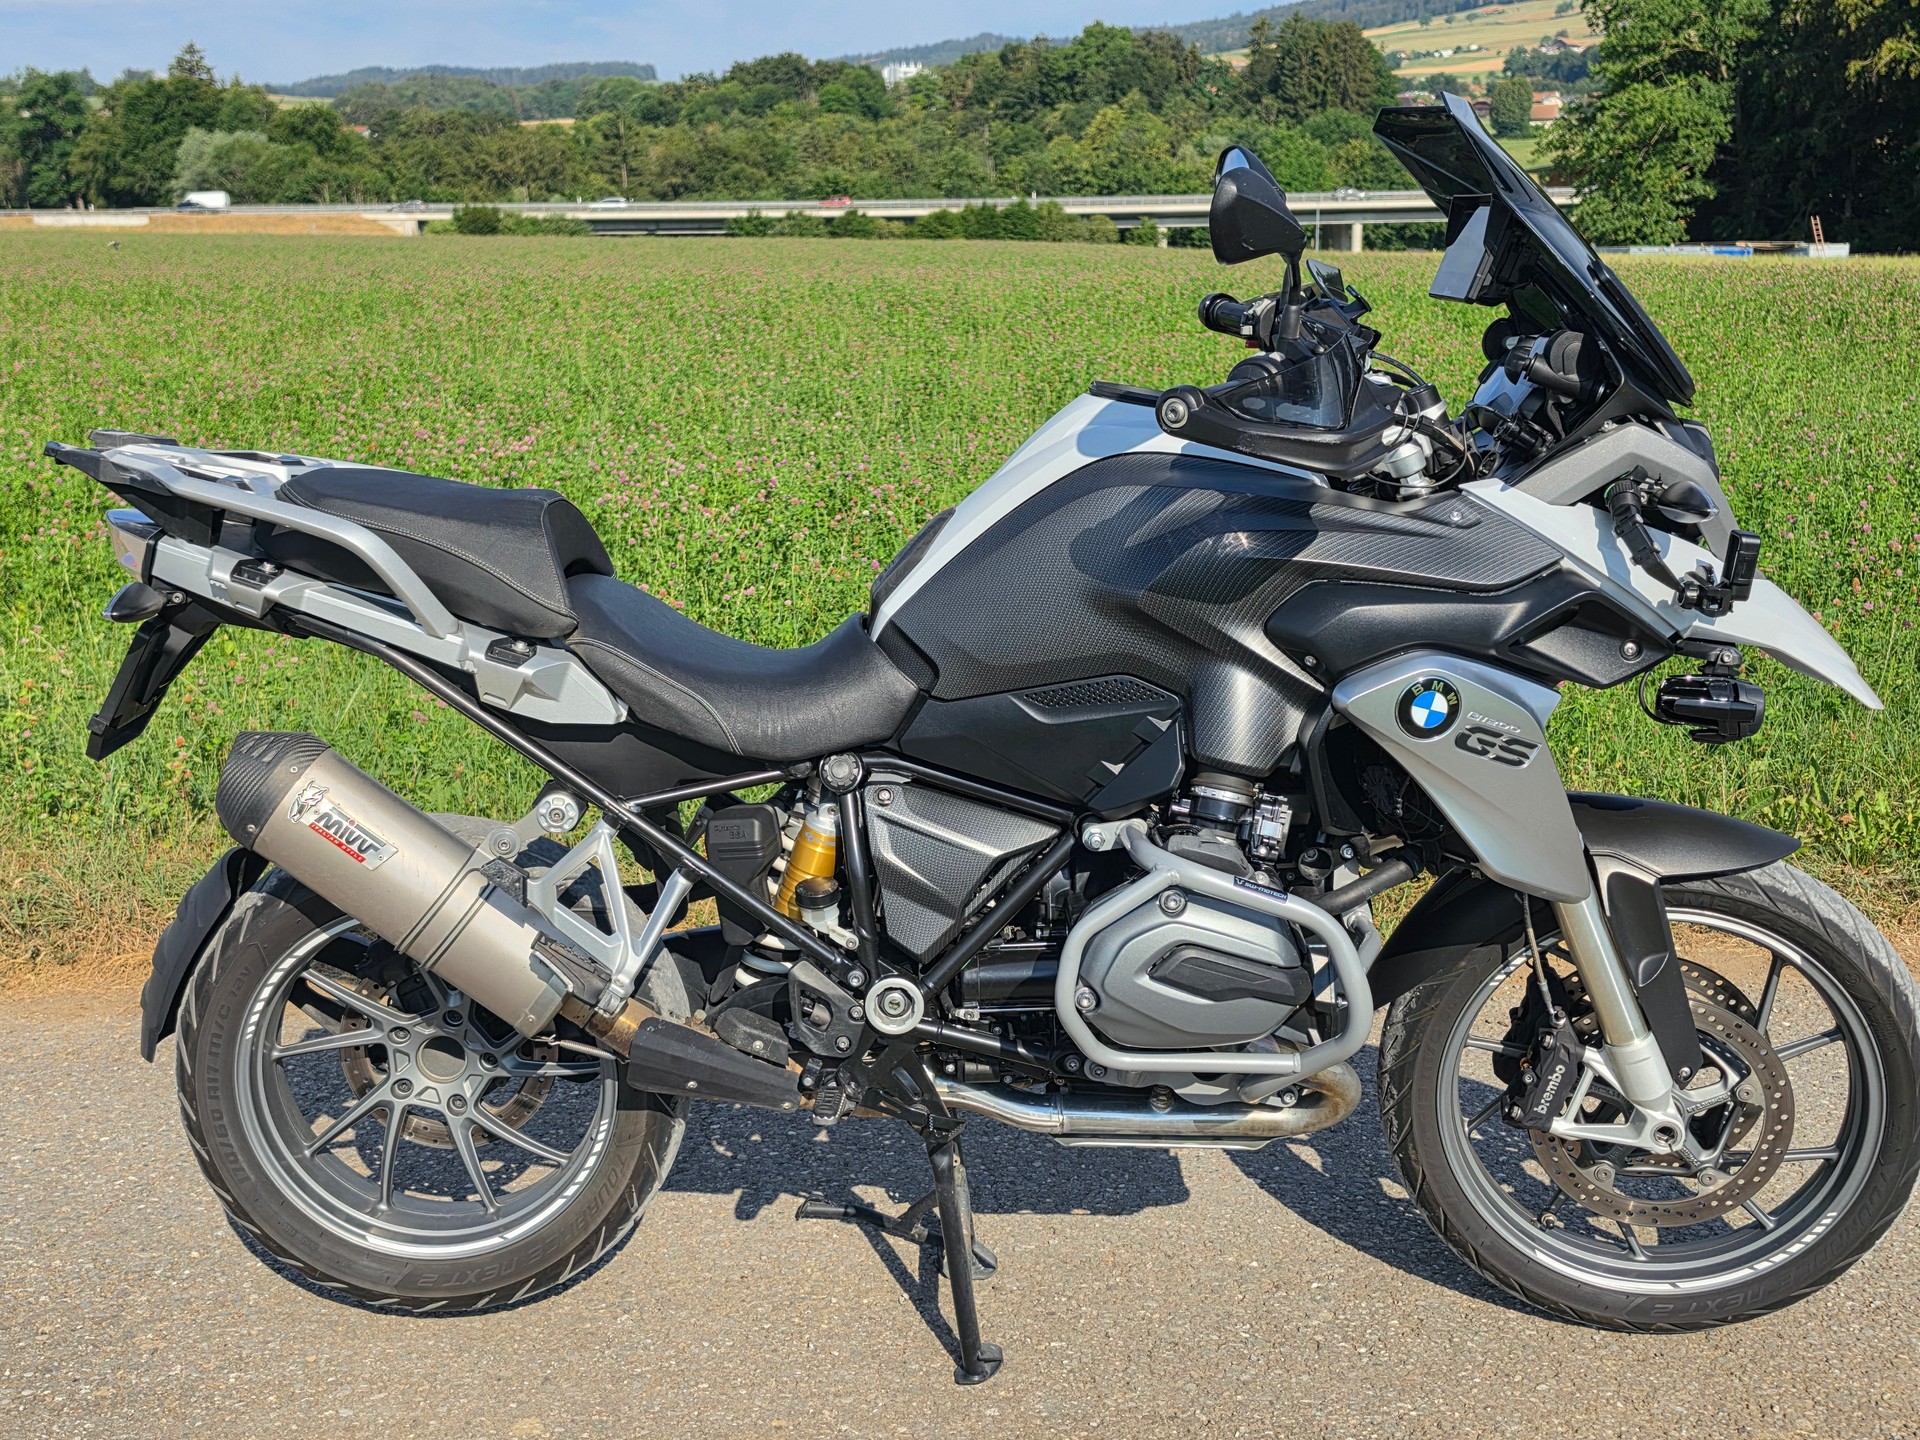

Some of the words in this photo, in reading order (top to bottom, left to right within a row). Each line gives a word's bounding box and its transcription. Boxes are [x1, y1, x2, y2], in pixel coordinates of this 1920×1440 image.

[1411, 680, 1458, 706] BMW
[1454, 725, 1542, 769] GS
[310, 823, 340, 845] ITALIAN
[340, 844, 364, 862] STYLE
[1533, 1064, 1566, 1115] brembo
